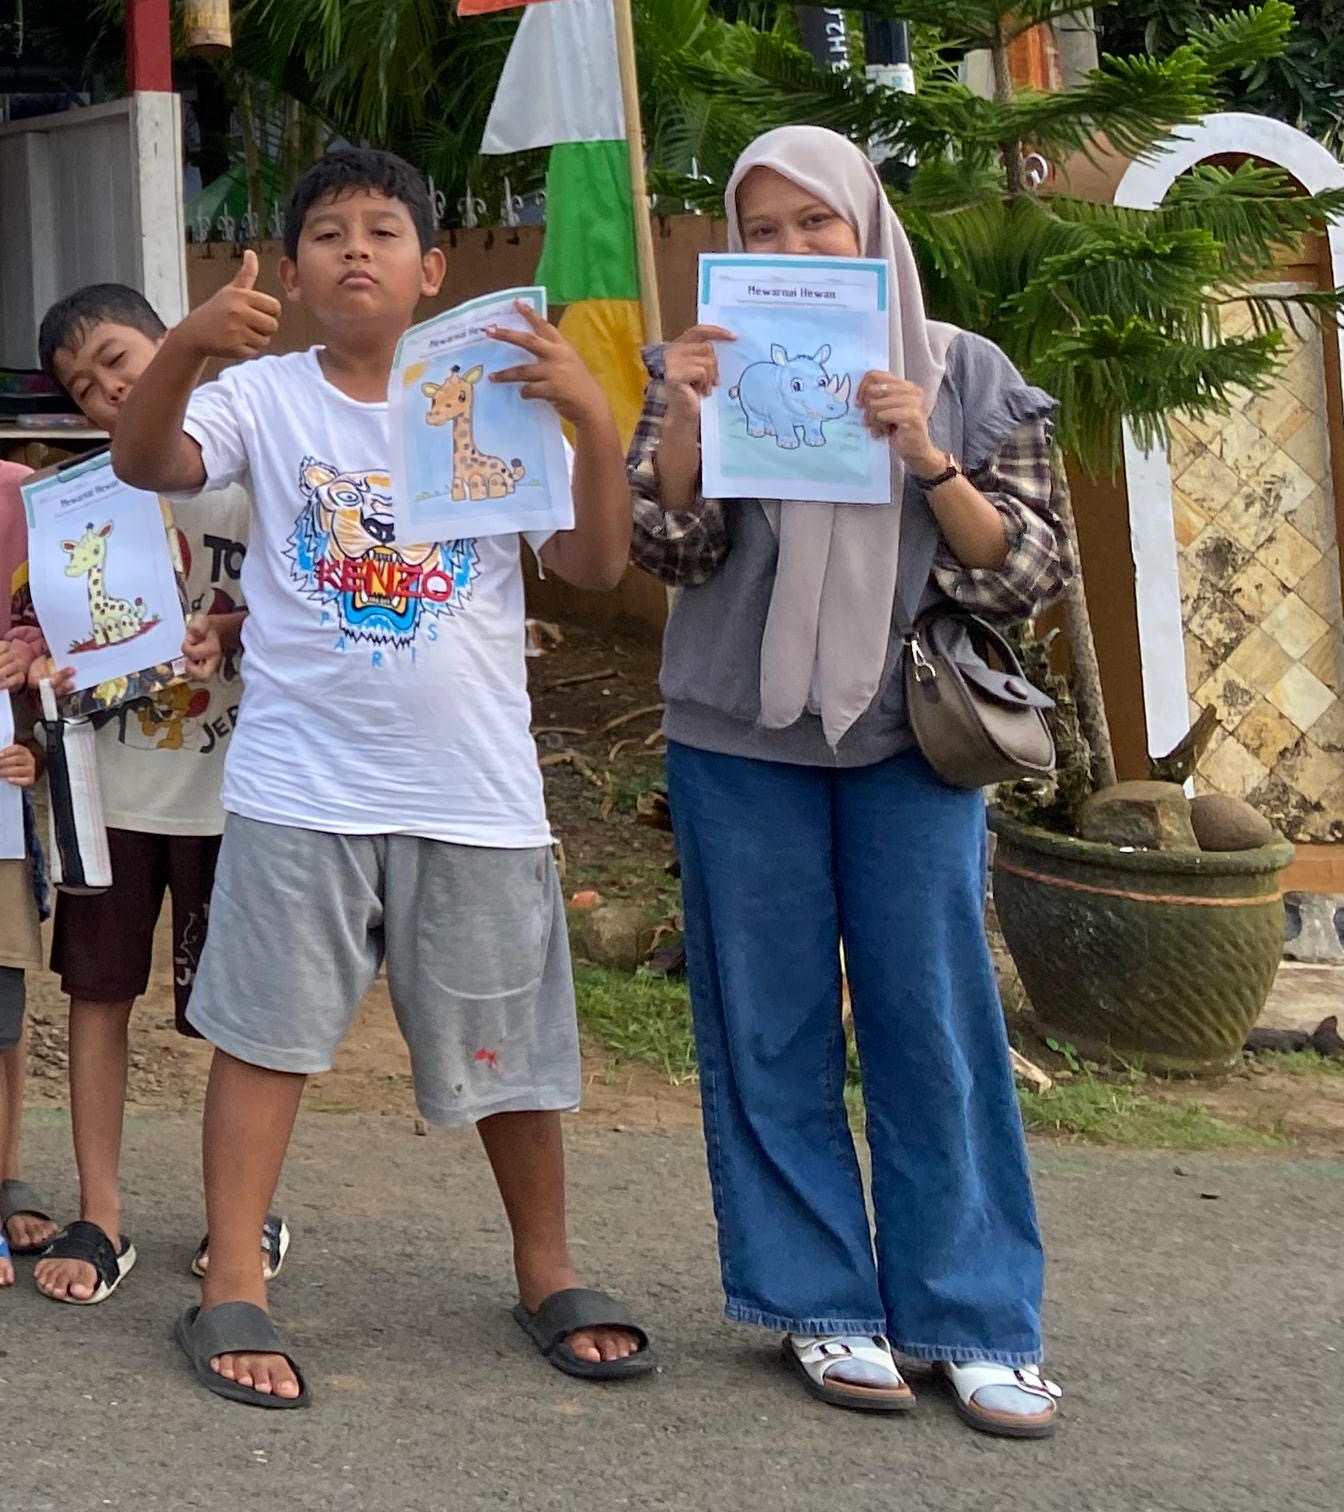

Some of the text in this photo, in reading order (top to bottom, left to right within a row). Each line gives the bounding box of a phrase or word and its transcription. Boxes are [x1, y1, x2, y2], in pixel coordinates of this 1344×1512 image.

[748, 285, 836, 299] Mewarnai Hewan
[203, 533, 247, 583] TO
[314, 557, 452, 603] KENZO
